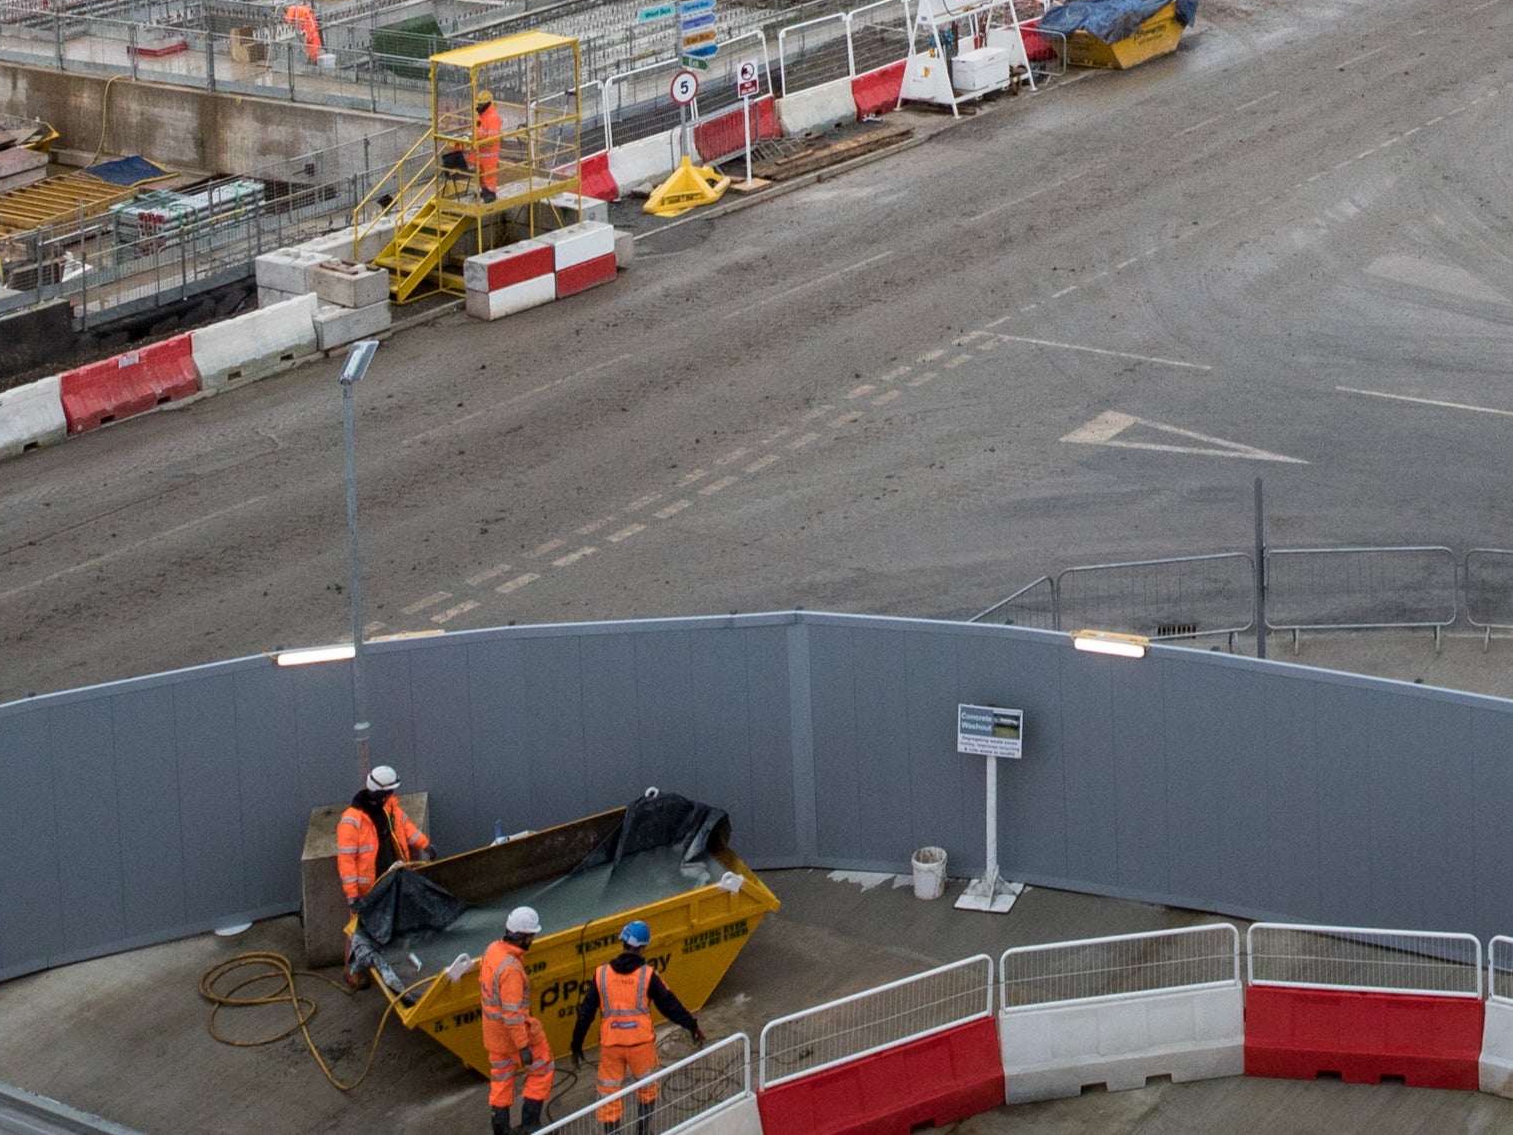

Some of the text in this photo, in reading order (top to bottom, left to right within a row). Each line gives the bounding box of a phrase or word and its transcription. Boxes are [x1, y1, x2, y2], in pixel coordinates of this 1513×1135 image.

[680, 81, 689, 94] 5
[961, 712, 992, 723] Concrete
[961, 721, 992, 732] Washout
